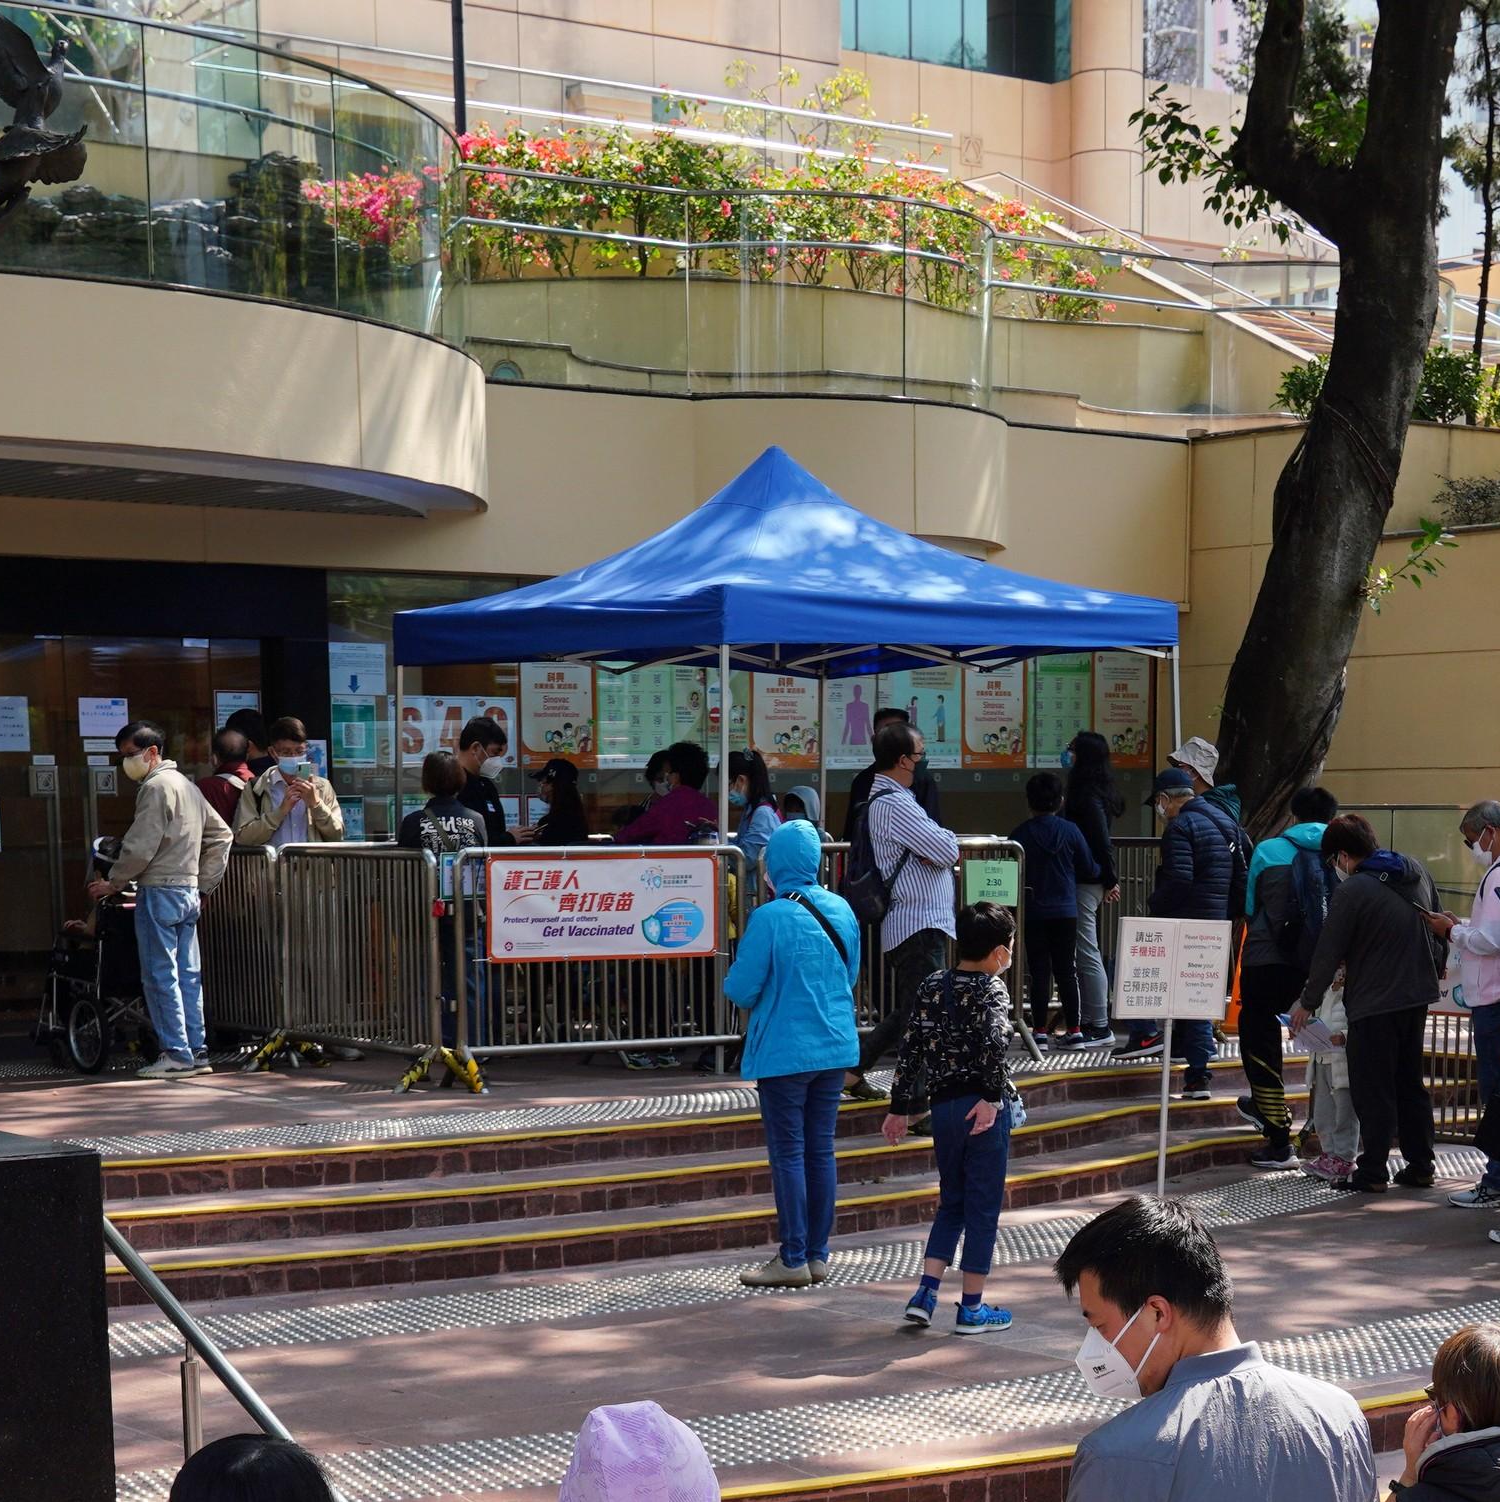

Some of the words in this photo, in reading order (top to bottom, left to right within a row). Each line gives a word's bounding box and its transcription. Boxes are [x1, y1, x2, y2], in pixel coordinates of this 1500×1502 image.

[503, 869, 580, 891] 護己護人
[986, 878, 1002, 887] 2:30
[558, 891, 635, 913] 齊打疫苗
[503, 916, 529, 924] Protect
[531, 915, 560, 925] yourself
[561, 915, 575, 923] and
[576, 915, 599, 923] others
[542, 925, 565, 938] Get
[568, 924, 635, 937] Vaccinated
[1135, 931, 1164, 943] 請出示
[1130, 945, 1166, 958] 手機短訊
[1132, 967, 1161, 978] 並按照
[1180, 971, 1205, 980] Booking
[1206, 971, 1220, 979] SMS
[1126, 995, 1163, 1007] 往前排隊
